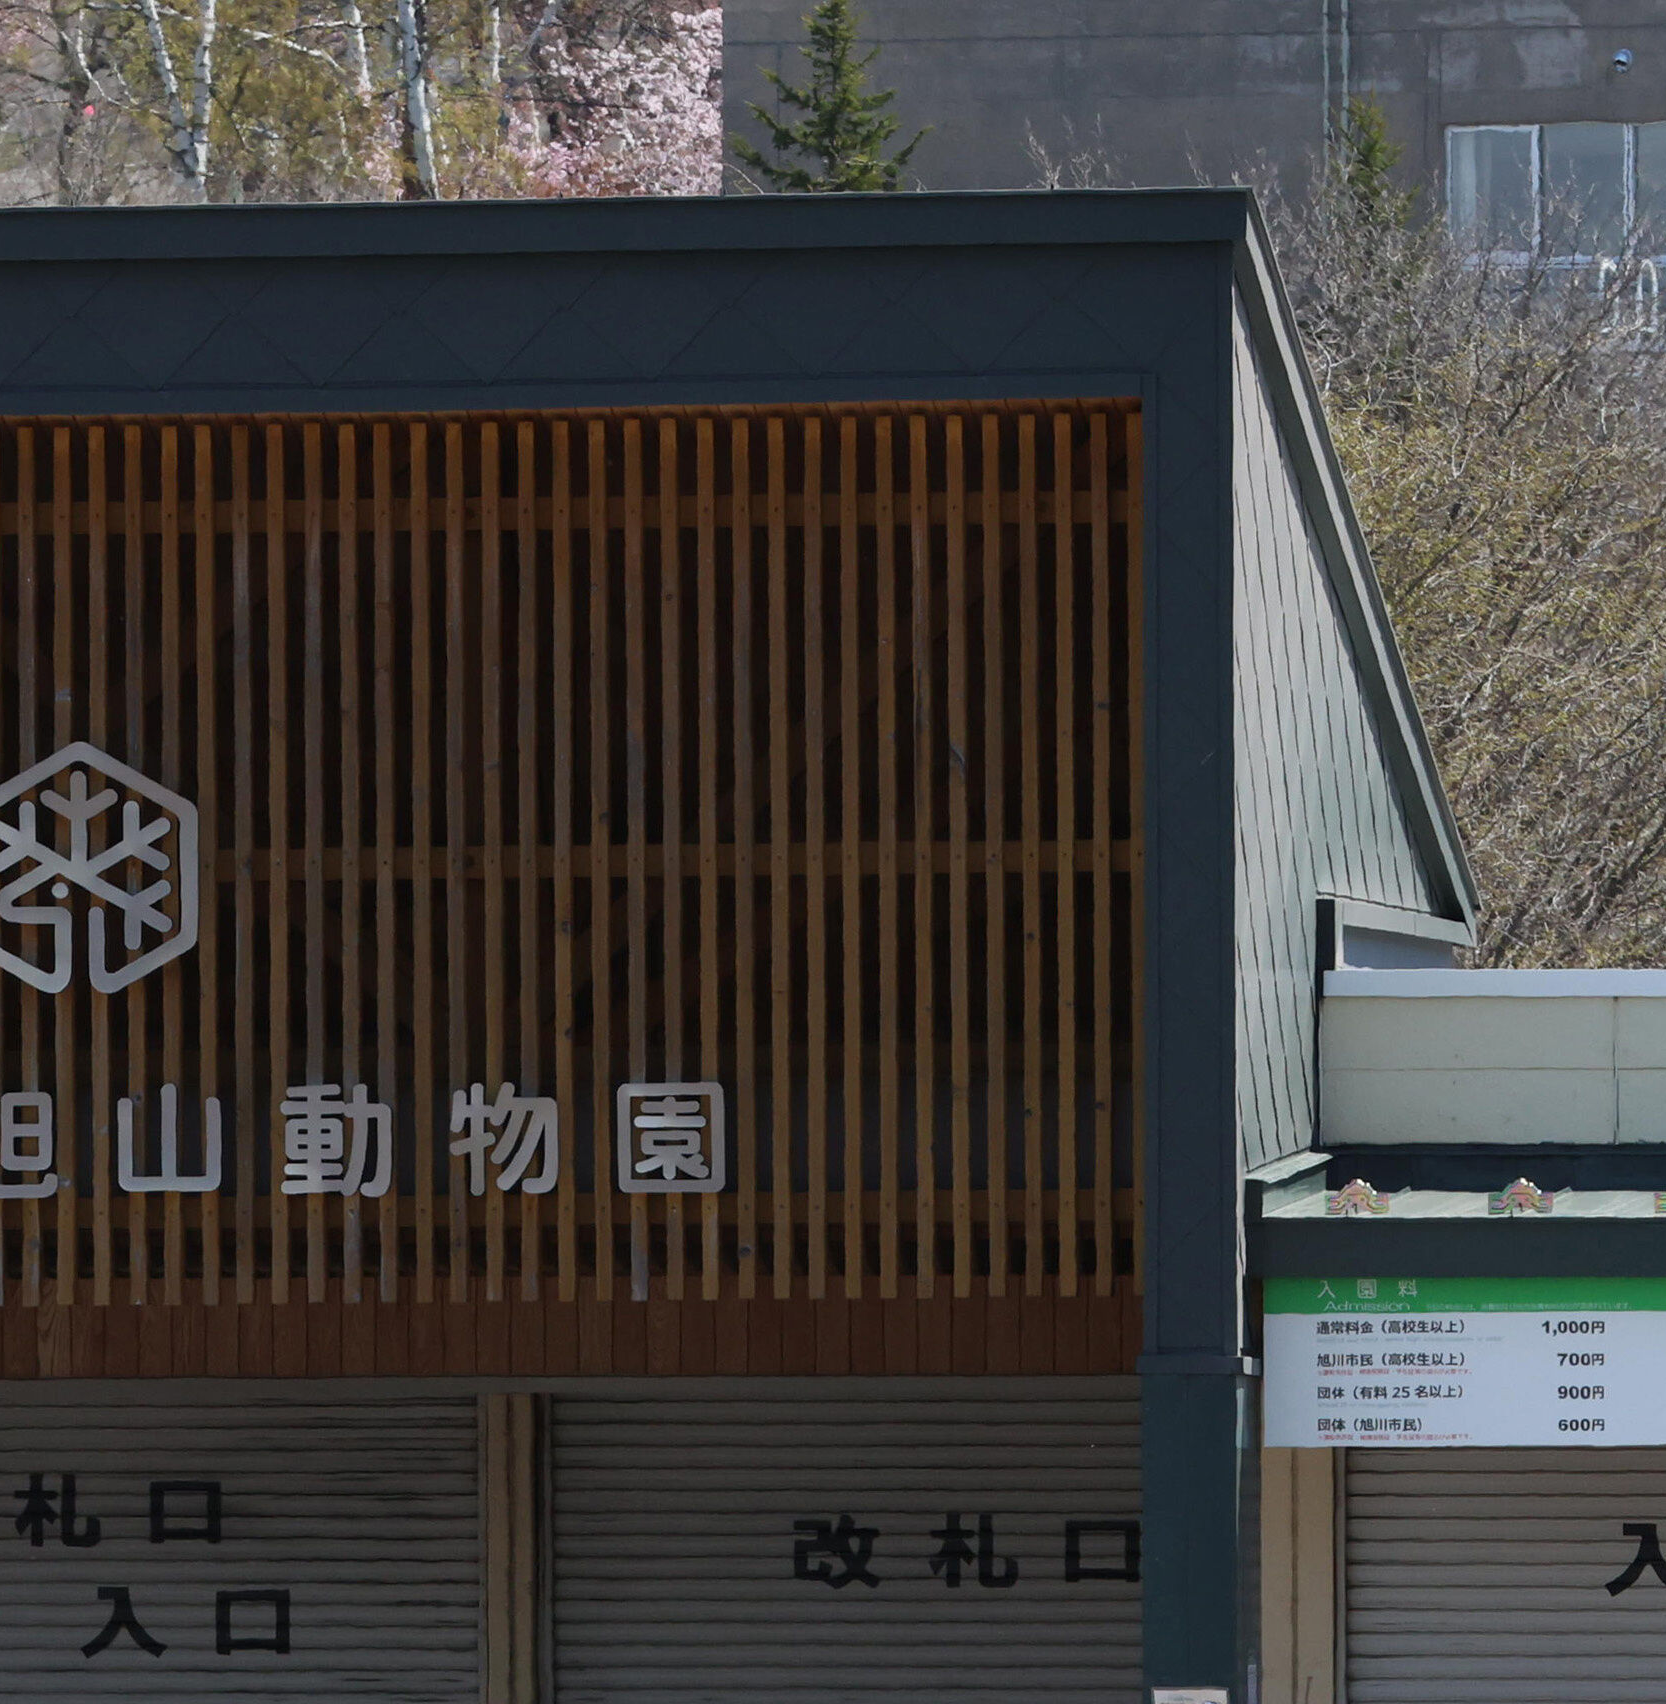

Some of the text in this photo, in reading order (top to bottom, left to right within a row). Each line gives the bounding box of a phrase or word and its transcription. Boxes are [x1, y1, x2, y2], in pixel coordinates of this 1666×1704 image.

[1316, 1279, 1418, 1299] 入園料
[1322, 1300, 1411, 1312] Admission
[1316, 1320, 1606, 1336] 通常料金（高校生以上） 1,000円
[1317, 1353, 1605, 1367] 旭川市民（高校生以上） 700円
[1557, 1385, 1605, 1400] 900円
[1317, 1418, 1605, 1432] 団体（旭川市民） 600円
[793, 1513, 1141, 1588] 改札口
[80, 1586, 292, 1660] 入口
